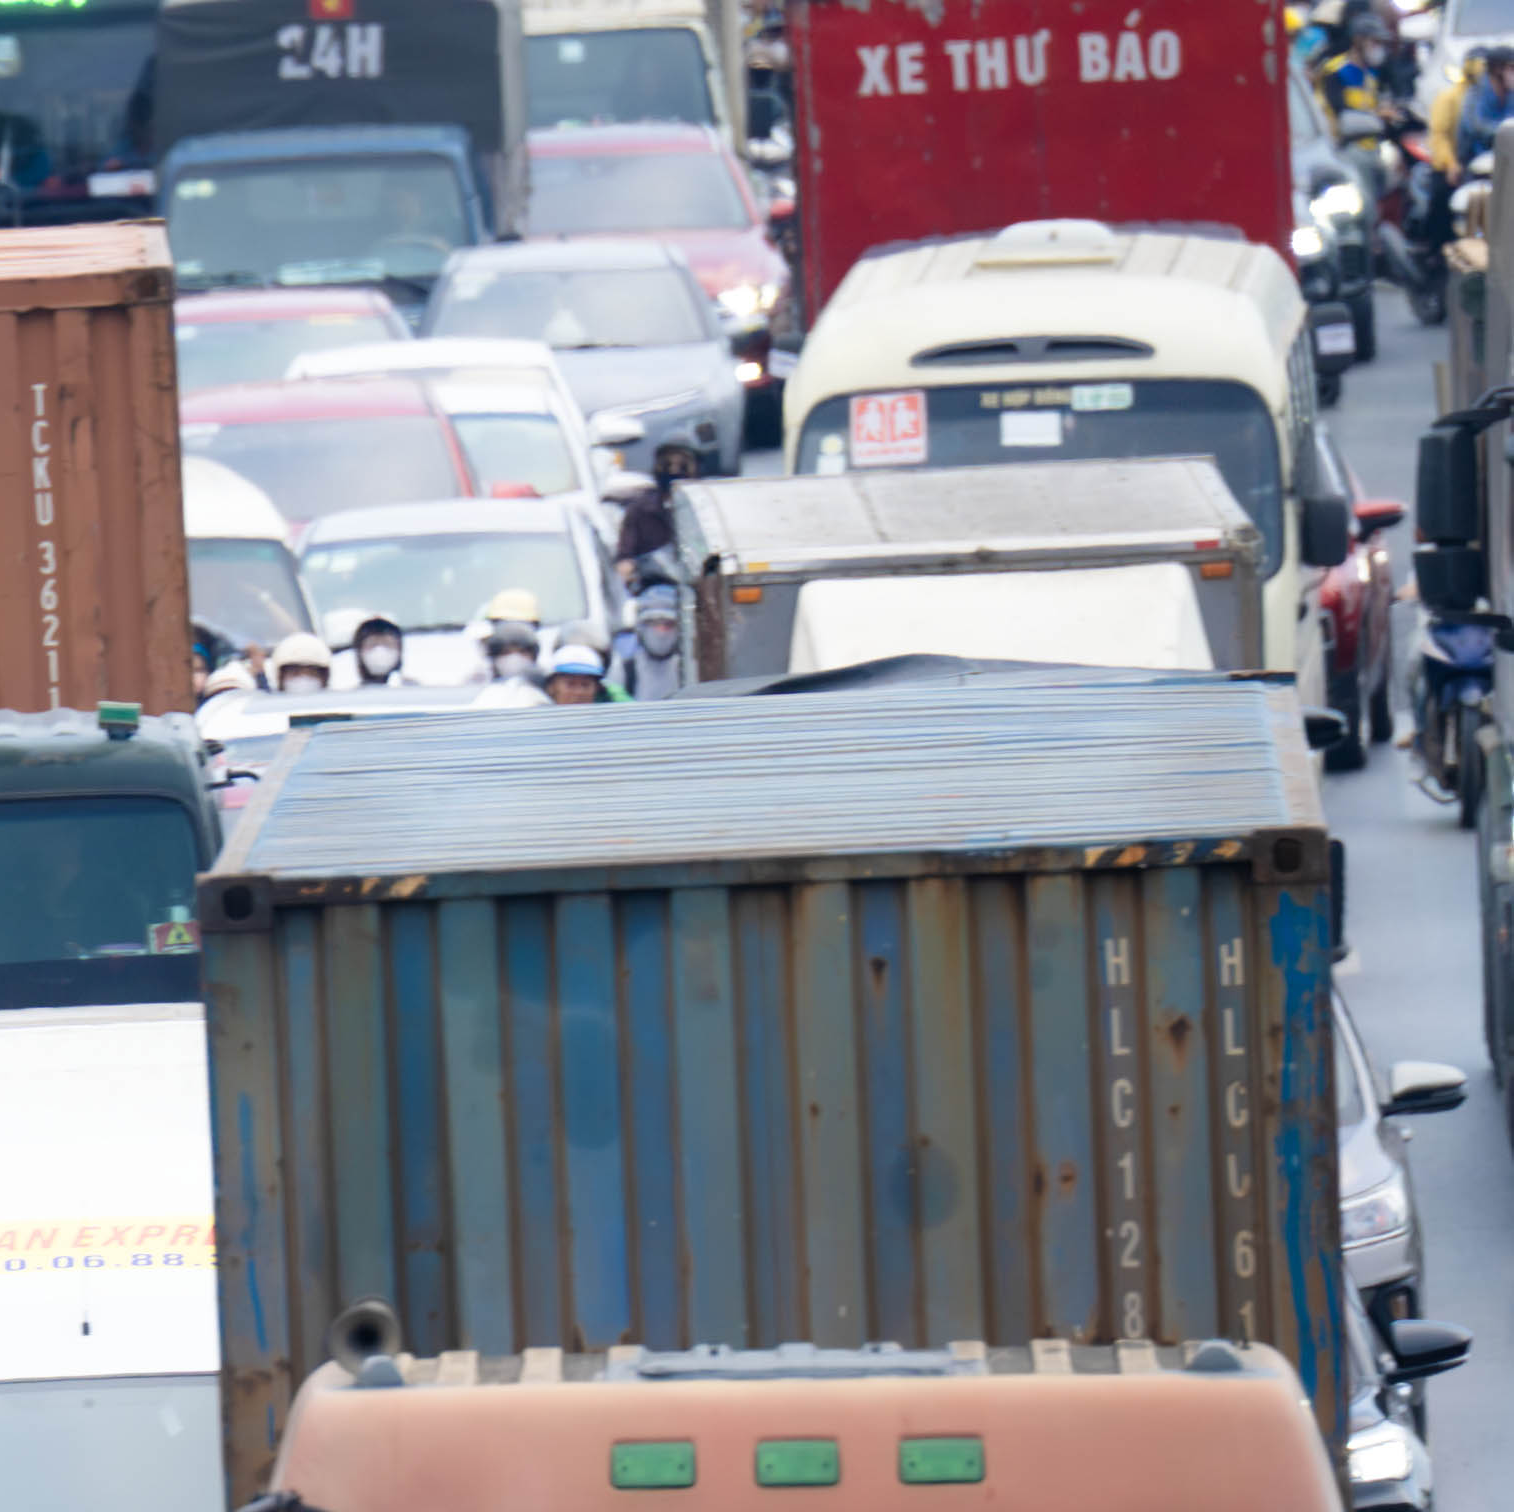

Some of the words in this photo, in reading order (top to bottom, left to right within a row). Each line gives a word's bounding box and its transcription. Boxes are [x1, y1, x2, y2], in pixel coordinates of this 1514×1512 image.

[857, 43, 927, 97] XE
[944, 28, 1051, 91] THƯ
[1078, 8, 1182, 82] BÁO
[31, 383, 54, 526] TCKU
